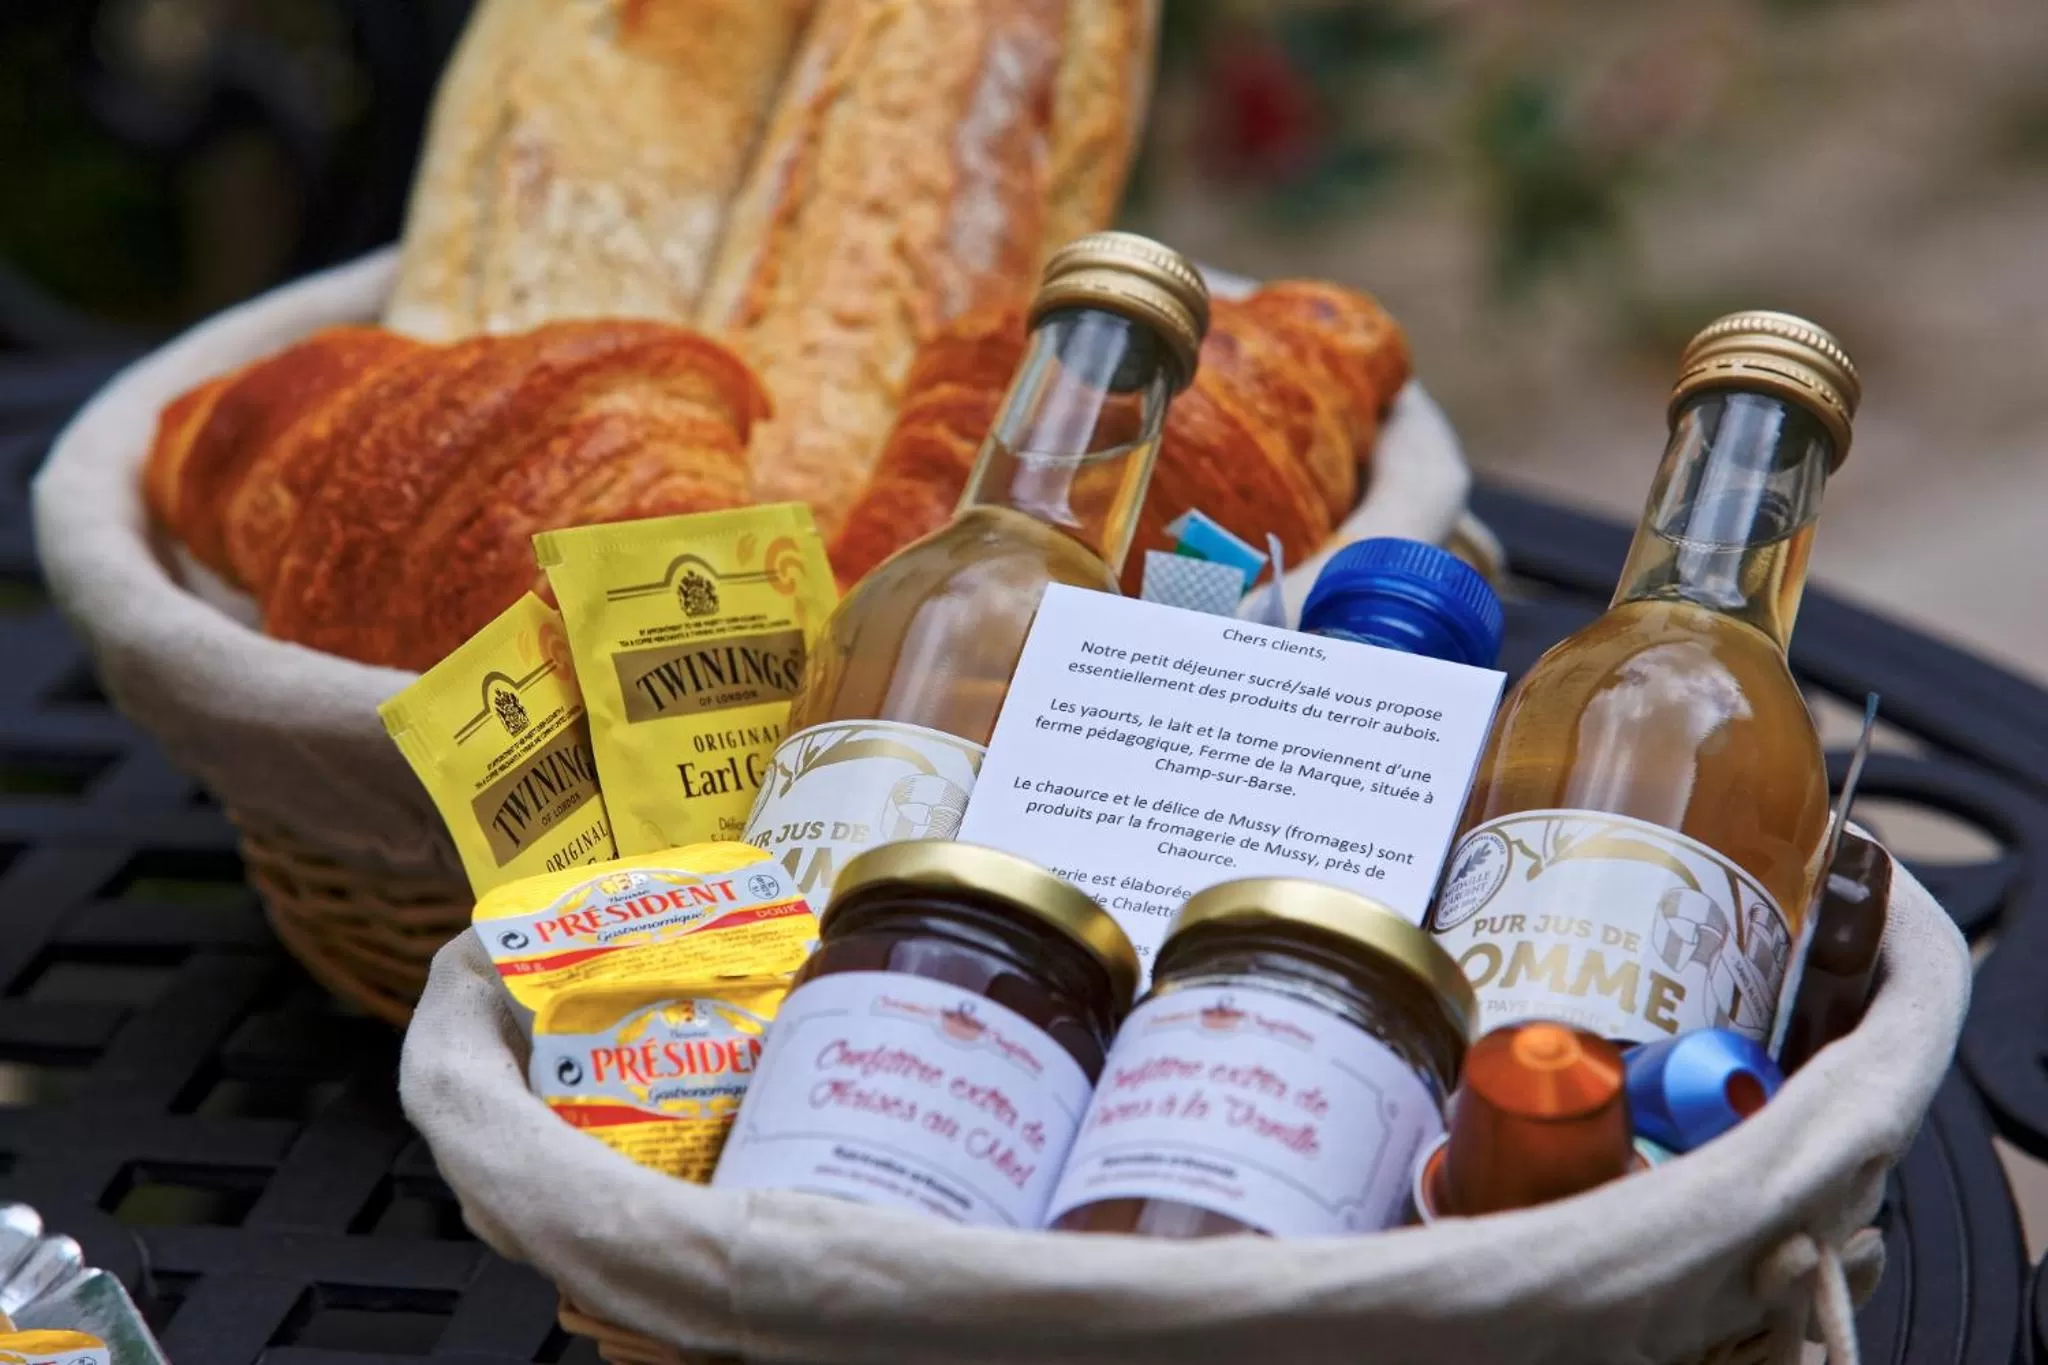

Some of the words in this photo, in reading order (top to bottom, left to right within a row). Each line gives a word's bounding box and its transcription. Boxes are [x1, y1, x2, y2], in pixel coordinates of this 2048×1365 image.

[1222, 627, 1267, 648] Chers
[1271, 638, 1327, 661] clients,
[636, 646, 800, 713] TWININGS
[699, 696, 713, 706] OF
[716, 689, 758, 705] LONDON
[1068, 660, 1196, 694] essentiellement
[1198, 683, 1227, 700] des
[1229, 688, 1298, 714] produits
[1302, 703, 1323, 719] du
[1327, 710, 1381, 730] terroir
[1383, 721, 1440, 743] aubois.
[1081, 640, 1127, 660] Notre
[1130, 650, 1169, 668] petit
[1173, 657, 1246, 682] déjeuner
[1248, 673, 1331, 700] sucré/salé
[1335, 691, 1372, 708] vous
[1375, 699, 1443, 722] propose
[1035, 715, 1083, 735] ferme
[1086, 726, 1194, 757] pédagogique,
[1199, 744, 1250, 765] Ferme
[1255, 754, 1275, 770] de
[1279, 759, 1293, 774] la
[1298, 764, 1366, 791] Marque,
[1370, 779, 1420, 802] située
[1423, 790, 1434, 805] à
[1050, 697, 1076, 713] Les
[1080, 705, 1143, 727] yaourts,
[1148, 713, 1164, 729] le
[1167, 717, 1192, 734] lait
[1196, 723, 1214, 738] et
[1217, 727, 1231, 742] la
[1236, 732, 1279, 751] tome
[1282, 743, 1381, 772] proviennent
[1385, 762, 1432, 783] d'une
[492, 743, 594, 849] TWINING
[676, 756, 743, 799] Earl
[1155, 757, 1297, 796] Champ-sur-Barse.
[542, 811, 552, 827] OF
[553, 791, 581, 821] LONDON
[775, 821, 825, 844] JUS
[830, 820, 871, 844] DE
[1013, 776, 1031, 790] Le
[1035, 779, 1109, 802] chaource
[1113, 792, 1131, 807] et
[1133, 794, 1148, 809] le
[1152, 798, 1200, 818] délice
[1203, 808, 1224, 823] de
[1228, 812, 1282, 837] Mussy
[1285, 824, 1374, 857] (fromages)
[1376, 847, 1415, 865] sont
[546, 819, 610, 873] ORIGINAL
[1026, 800, 1093, 820] produits
[1095, 811, 1124, 826] par
[1128, 814, 1142, 829] la
[1146, 817, 1235, 846] fromagerie
[1240, 836, 1260, 852] de
[1264, 841, 1320, 867] Mussy,
[1325, 855, 1361, 874] près
[1365, 864, 1386, 880] de
[1157, 841, 1237, 868] Chaource.
[533, 880, 739, 944] PRÉSIDENT
[1091, 874, 1117, 887] est
[1120, 876, 1192, 900] élaborée
[596, 911, 703, 943] Gastronomique
[1472, 913, 1527, 938] PUR
[1533, 912, 1592, 938] JUS
[1600, 923, 1642, 954] DE
[1458, 939, 1688, 1036] OMME
[590, 1034, 763, 1087] PRÉSIDEN
